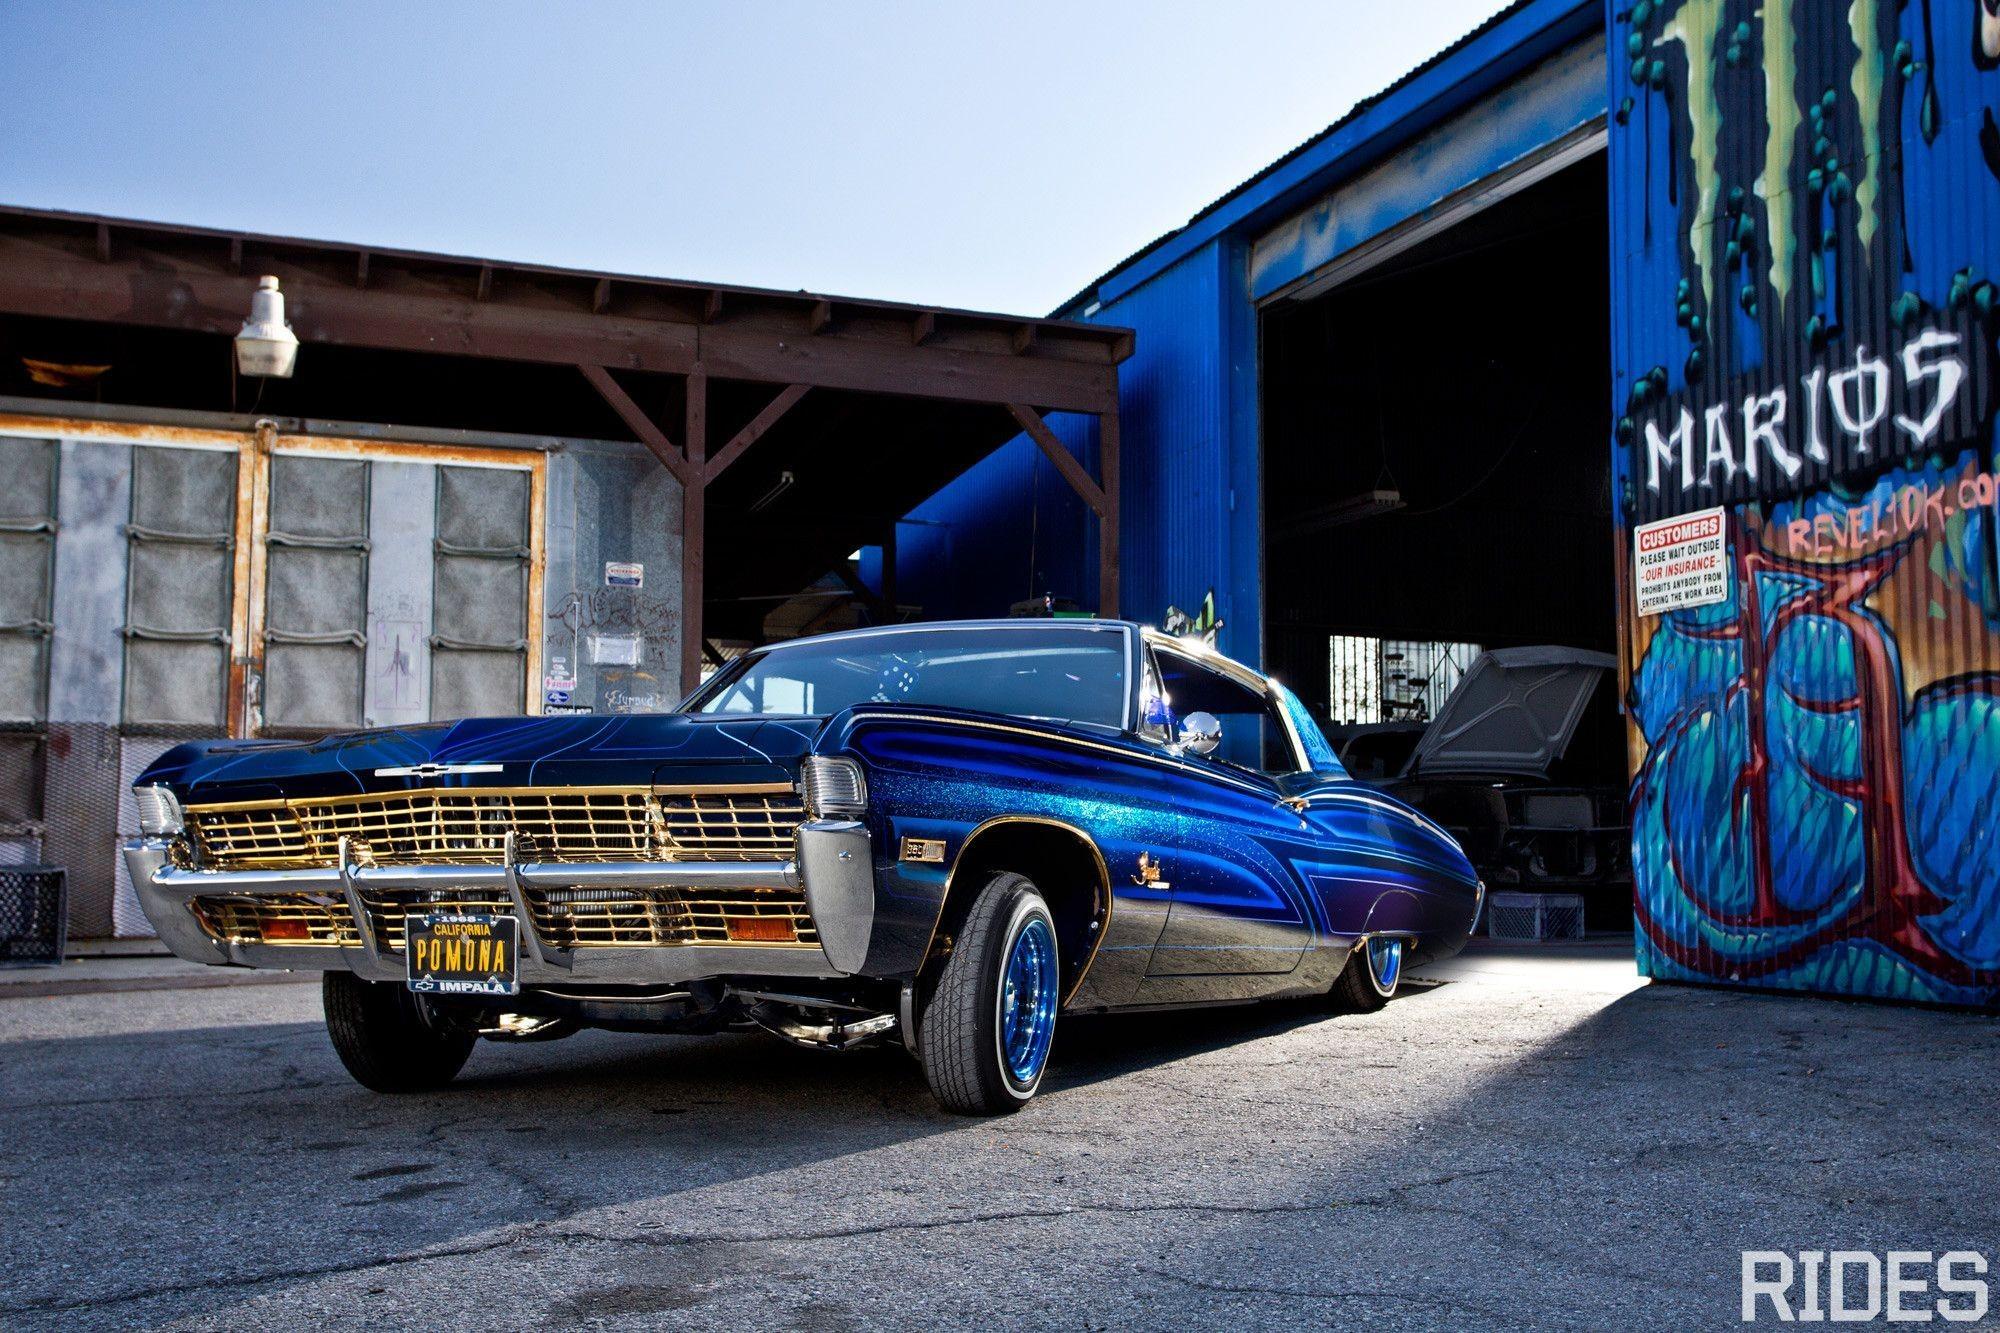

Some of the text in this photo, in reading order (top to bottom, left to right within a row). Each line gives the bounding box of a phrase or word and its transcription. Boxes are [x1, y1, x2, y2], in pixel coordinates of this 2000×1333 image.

[1642, 517, 1718, 549] CUSTOMERS
[1640, 539, 1720, 566] PLEASE WAIT OUTSIDE
[1641, 571, 1722, 596] PROHIBITS ANYBODY FROM
[1642, 584, 1723, 608] ENTERING THE WORK AREA
[434, 924, 491, 936] CALIFORNIA
[417, 939, 505, 972] POMONA
[439, 982, 507, 993] IMPALA
